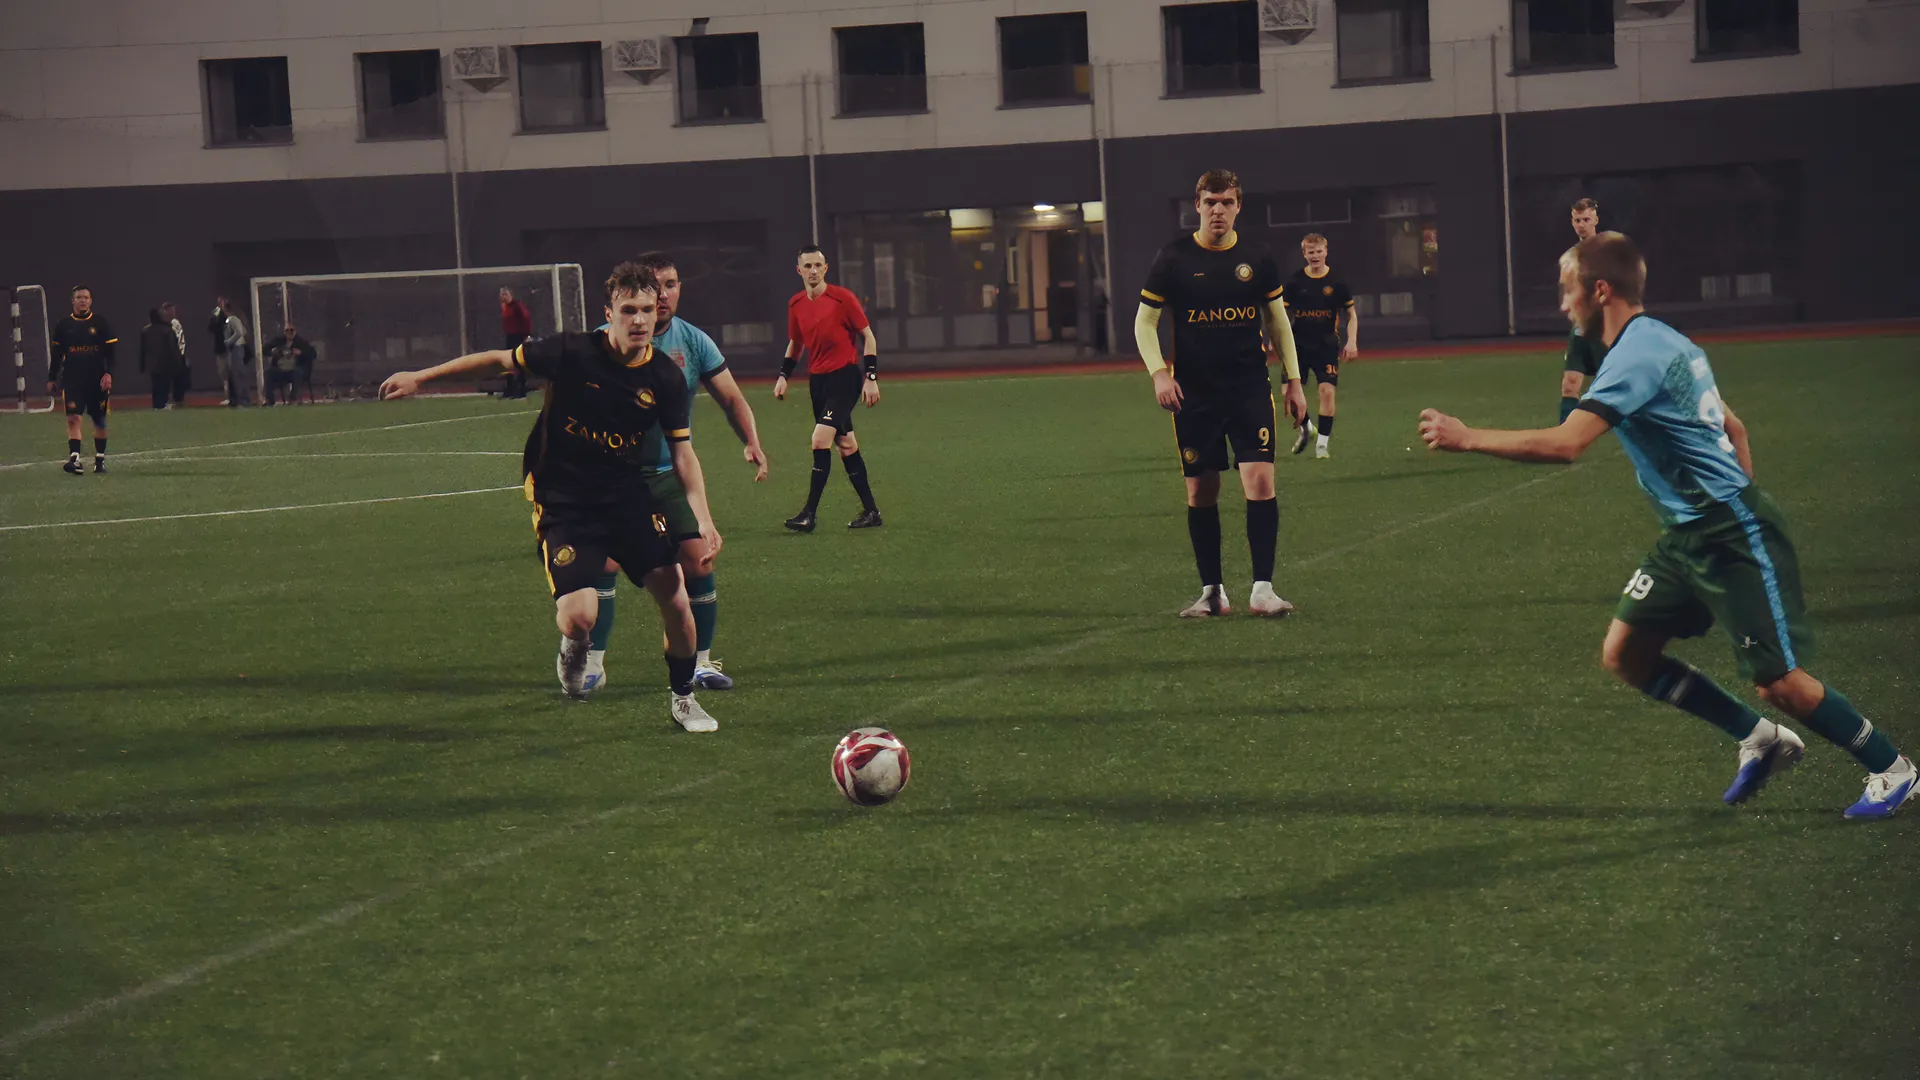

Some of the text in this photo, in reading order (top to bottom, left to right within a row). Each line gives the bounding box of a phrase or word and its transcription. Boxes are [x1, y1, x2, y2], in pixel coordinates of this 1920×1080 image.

[1187, 306, 1256, 323] ZANOVO
[564, 415, 643, 449] ZANO
[1257, 427, 1270, 446] 9
